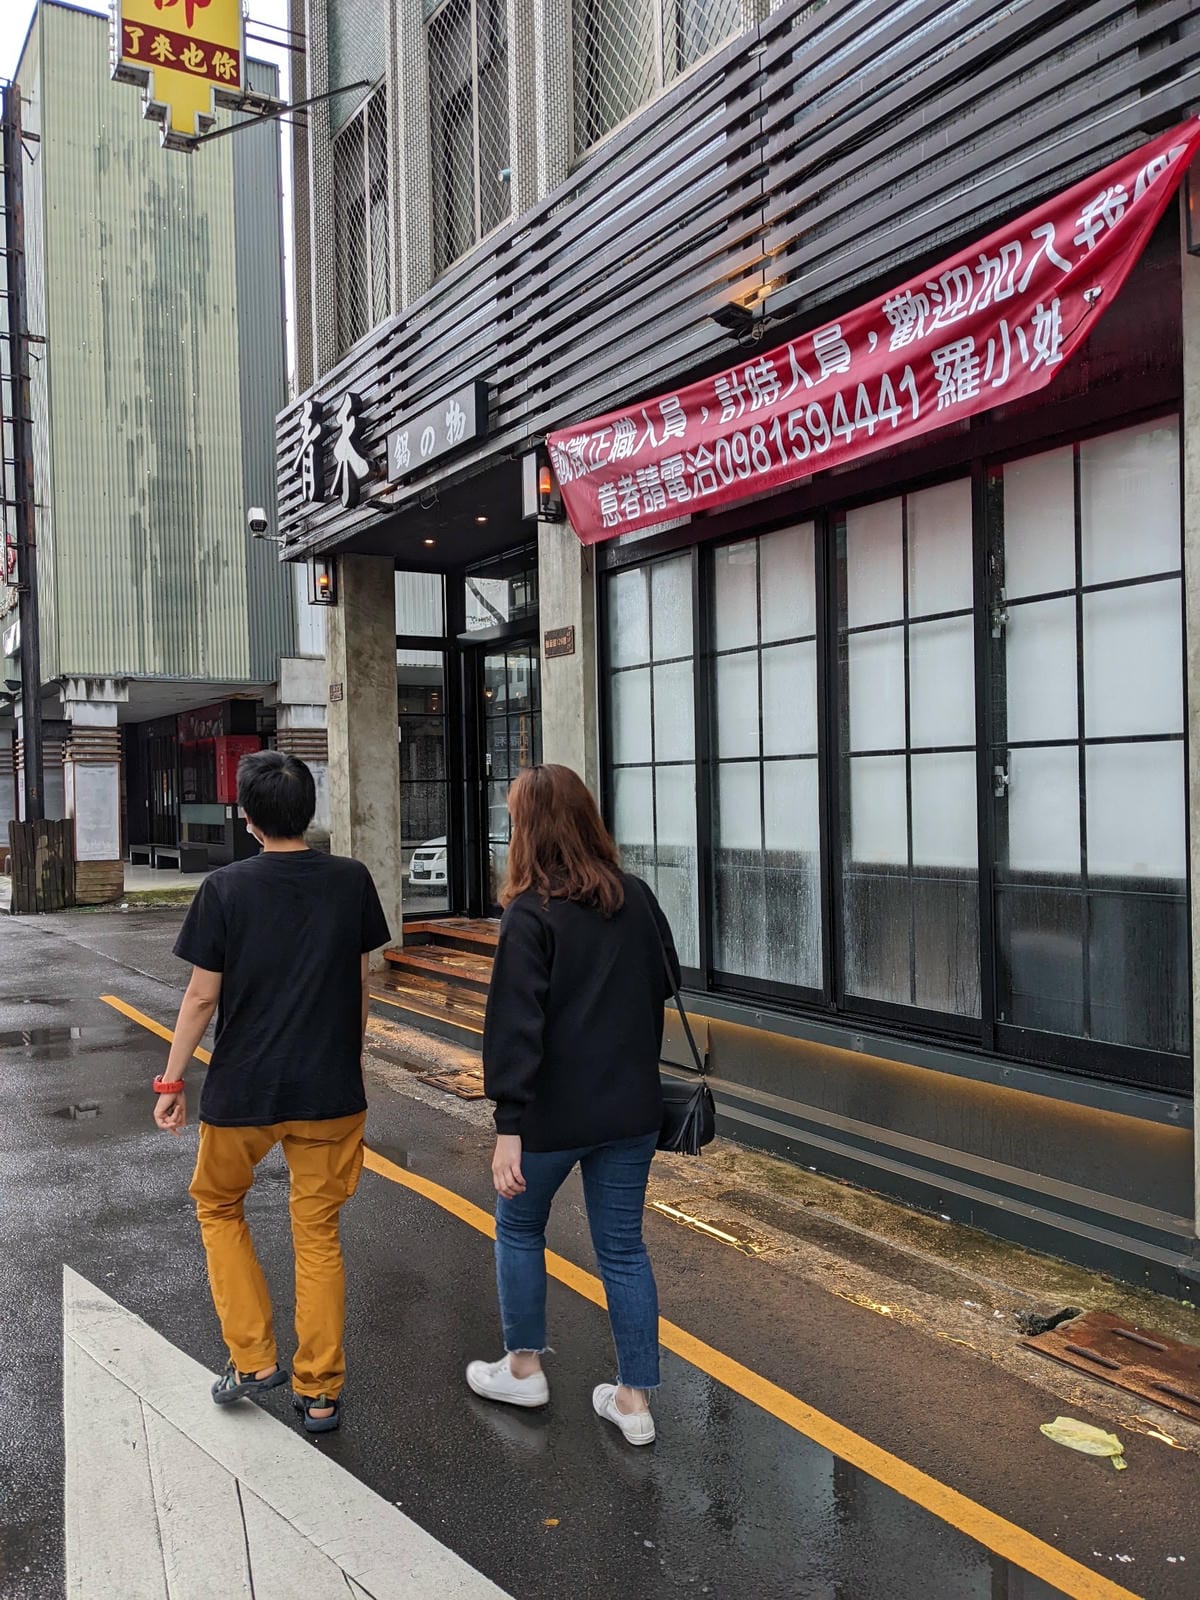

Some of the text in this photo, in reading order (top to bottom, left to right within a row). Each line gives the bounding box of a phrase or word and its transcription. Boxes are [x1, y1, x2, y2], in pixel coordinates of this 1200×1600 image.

[931, 298, 1063, 411] 羅小姐
[293, 392, 370, 508] 青木
[394, 399, 467, 470] 鍋の物
